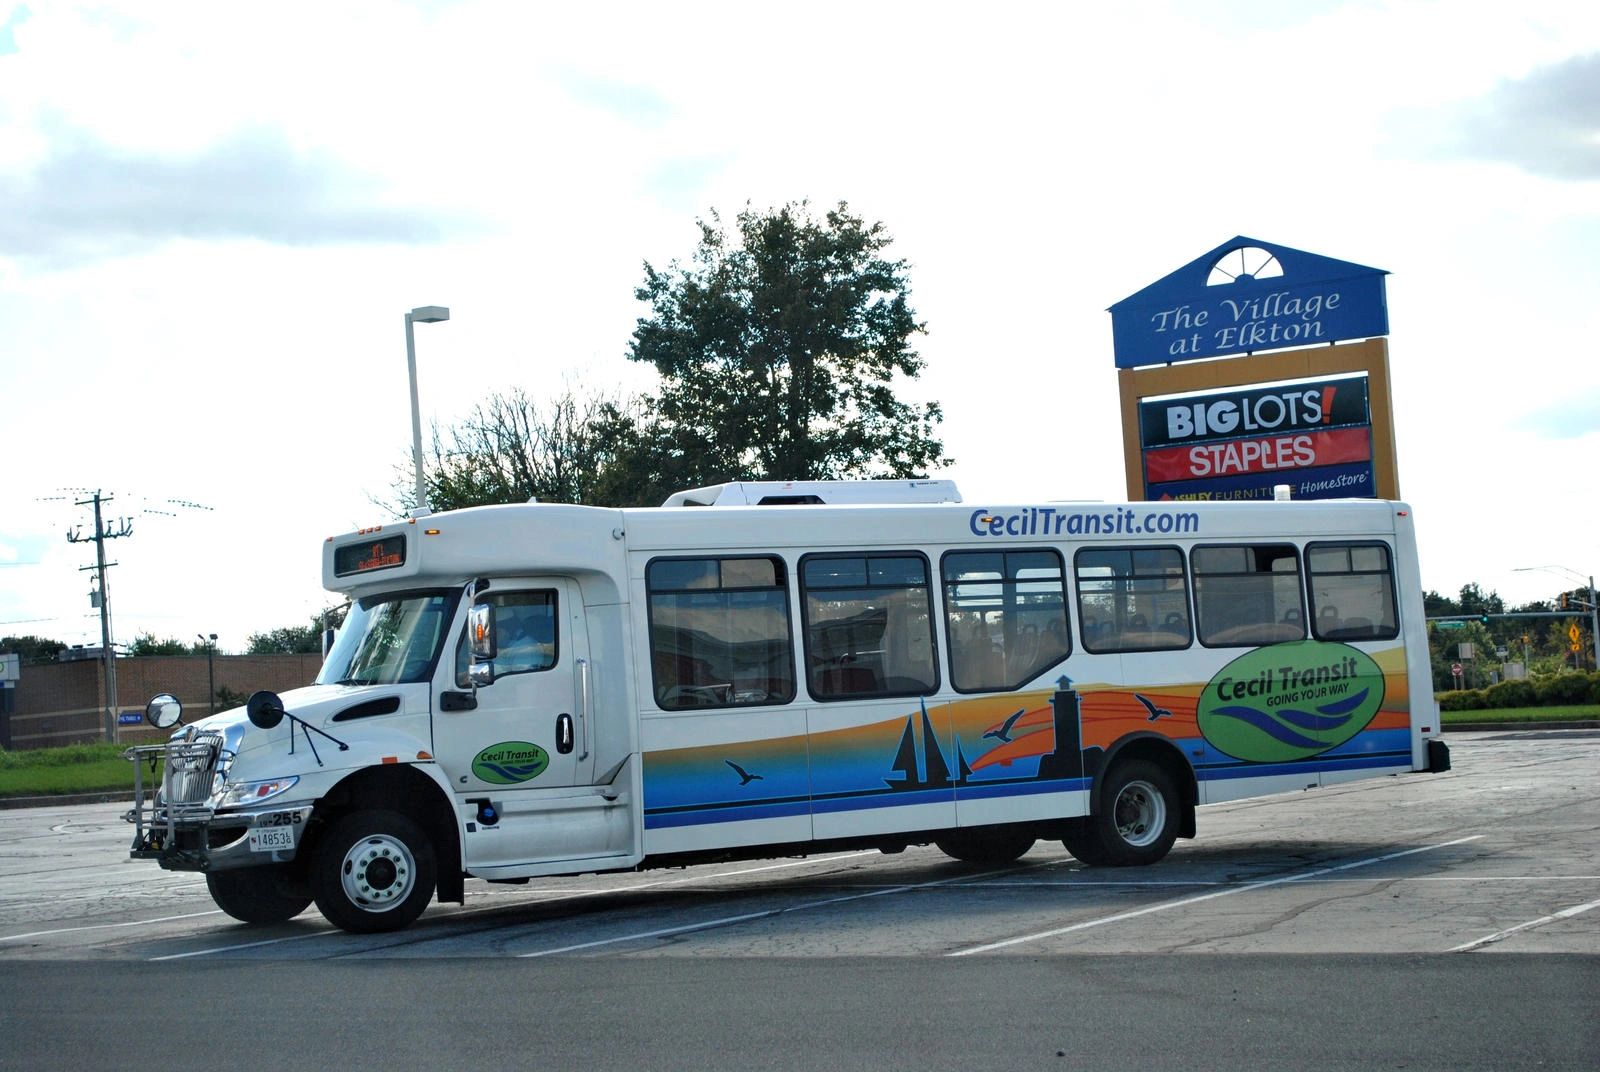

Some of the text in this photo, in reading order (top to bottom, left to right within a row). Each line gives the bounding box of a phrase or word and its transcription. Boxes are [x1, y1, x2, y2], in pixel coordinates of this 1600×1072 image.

[1151, 291, 1341, 333] The Village
[1169, 320, 1325, 355] at Elkton
[1189, 435, 1316, 477] STAPLES
[969, 507, 1199, 537] CecilTransit.com
[1217, 656, 1358, 701] Cecil Transit
[1266, 682, 1350, 707] GOING YOUR WAY
[481, 749, 539, 761] Cecil Transit
